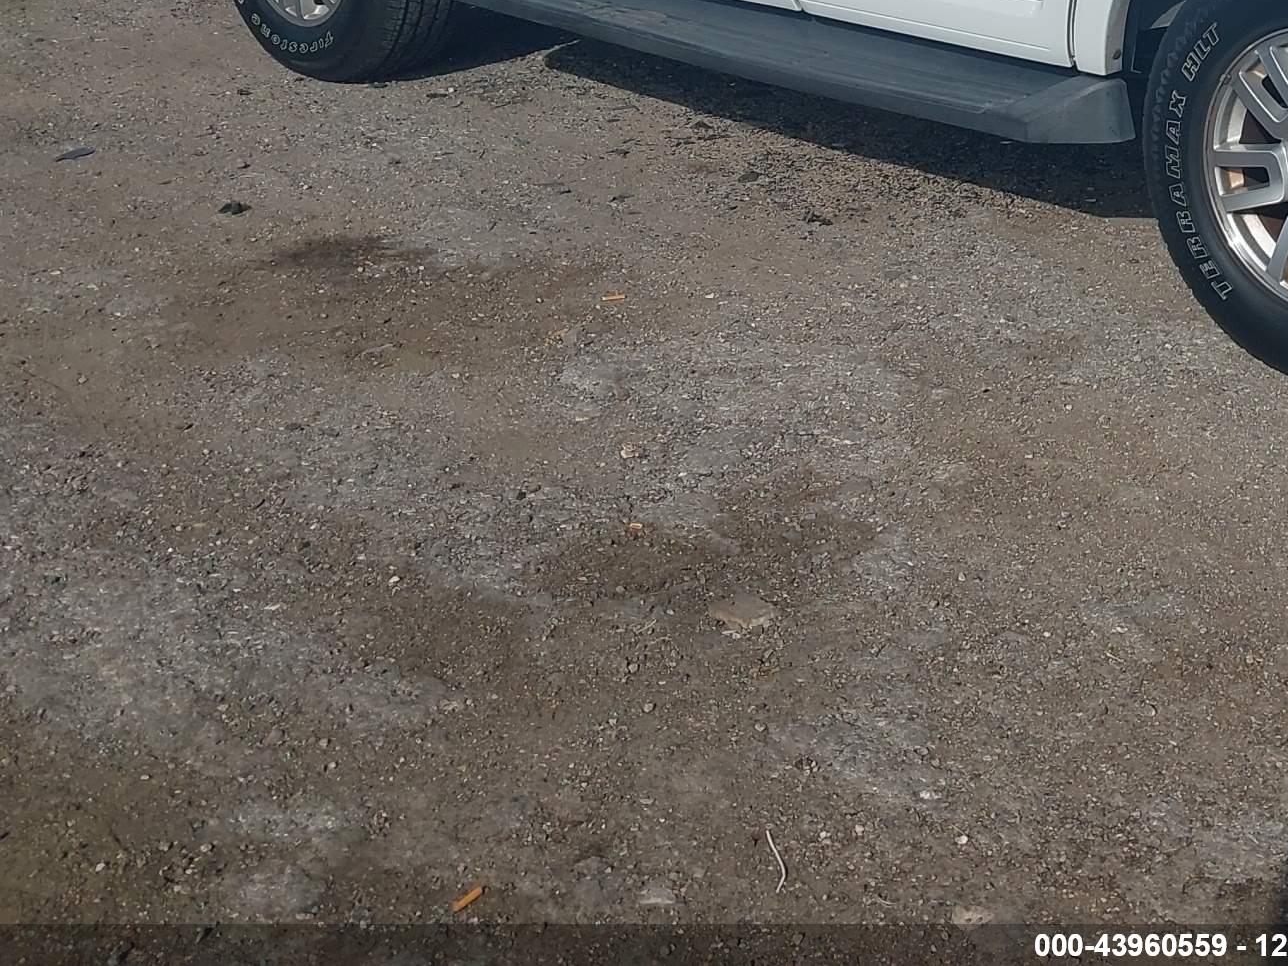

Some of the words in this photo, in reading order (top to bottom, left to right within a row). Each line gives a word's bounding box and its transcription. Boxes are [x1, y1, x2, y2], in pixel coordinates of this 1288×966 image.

[251, 13, 334, 54] Firestone
[1181, 22, 1220, 82] HLT
[1163, 90, 1233, 301] TERRAMAX
